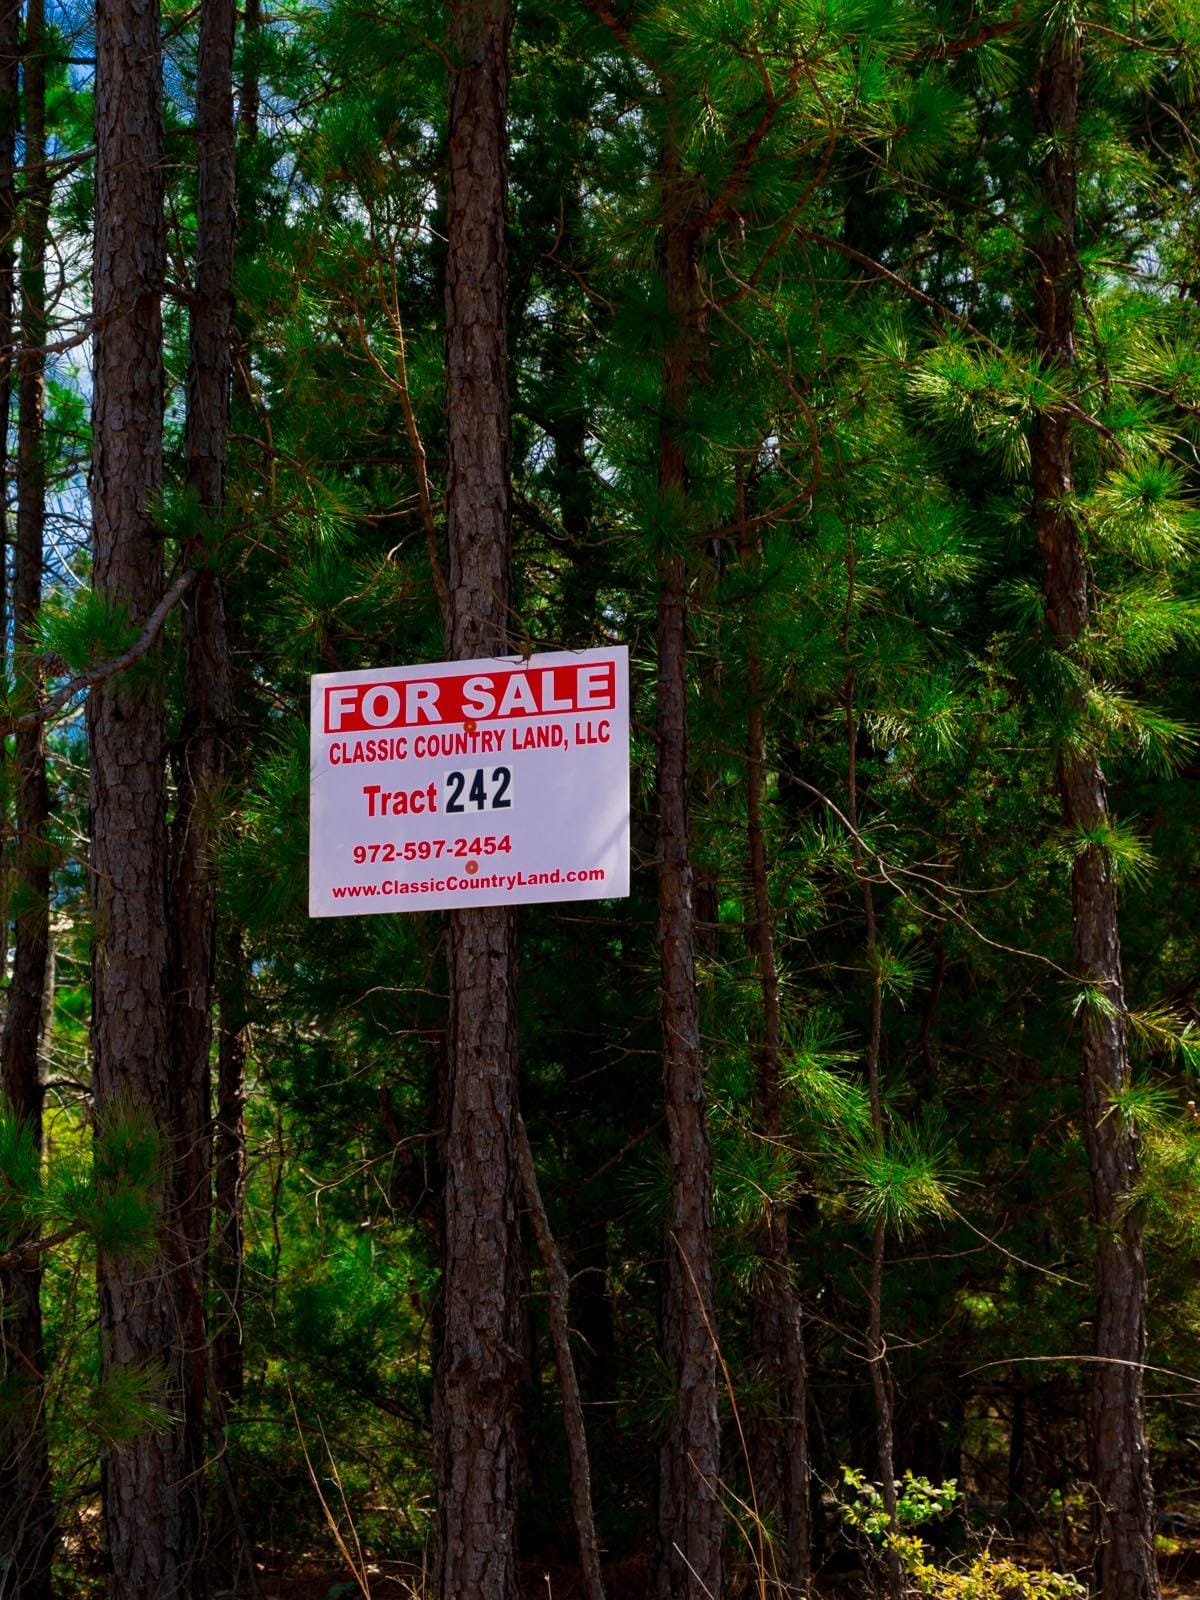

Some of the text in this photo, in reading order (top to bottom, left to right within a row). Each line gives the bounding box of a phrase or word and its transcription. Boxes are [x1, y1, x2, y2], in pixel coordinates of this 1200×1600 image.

[328, 665, 611, 731] FOR SALE
[329, 720, 611, 765] CLASSIC COUNTRY LAND, LLC
[363, 766, 512, 817] Tract 242
[353, 835, 512, 864] 972-597-2454
[332, 868, 605, 898] www.ClassicCountryLand.com
